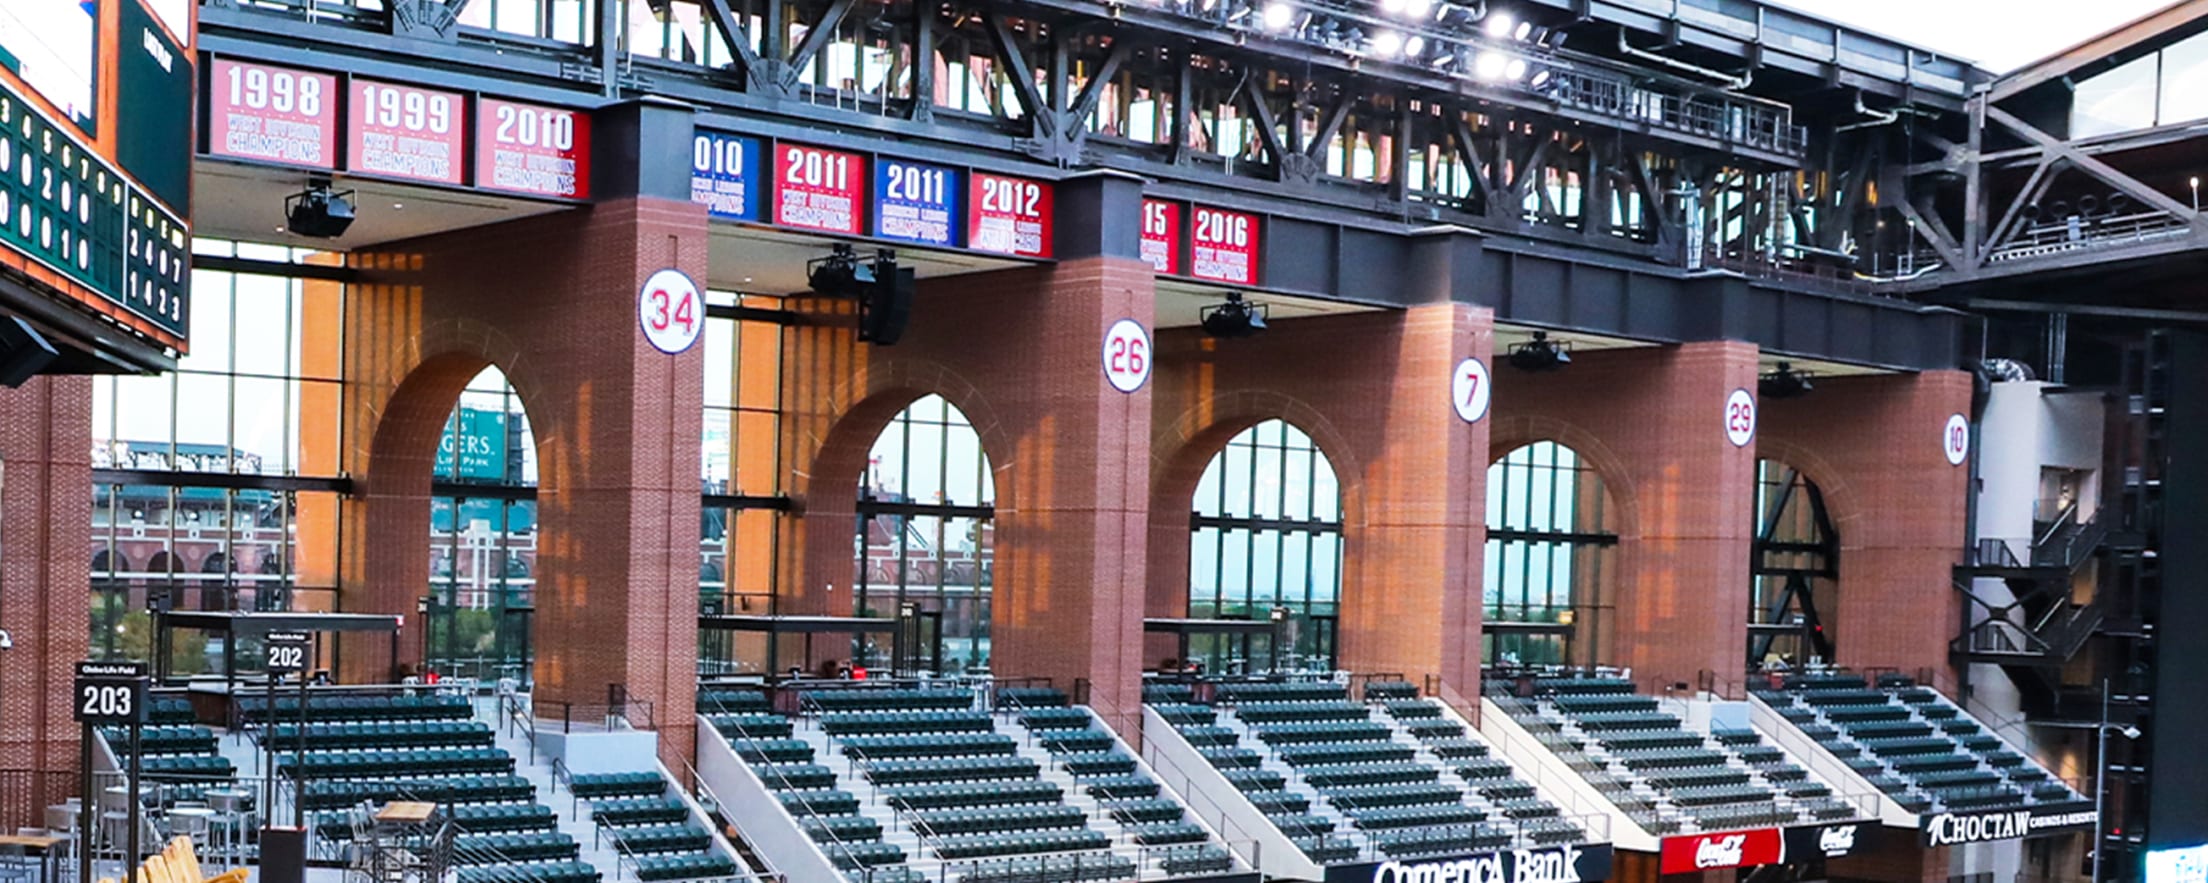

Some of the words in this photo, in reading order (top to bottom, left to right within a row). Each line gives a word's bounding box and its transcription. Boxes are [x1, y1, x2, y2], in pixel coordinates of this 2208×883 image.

[227, 65, 320, 117] 1998
[363, 85, 449, 133] 1999
[23, 115, 31, 139] 4
[44, 129, 52, 154] 5
[80, 157, 88, 181] 7
[225, 130, 321, 163] CHAMPIONS
[496, 105, 573, 151] 2010
[694, 136, 743, 175] 010
[786, 148, 847, 190] 2011
[886, 164, 943, 204] 2011
[981, 177, 1040, 217] 2012
[0, 137, 10, 172] 0
[22, 152, 32, 187] 0
[42, 167, 52, 200] 2
[61, 180, 71, 212] 0
[80, 193, 89, 224] 0
[130, 228, 138, 257] 2
[145, 239, 153, 266] 4
[160, 249, 167, 275] 0
[173, 258, 181, 283] 7
[1144, 202, 1167, 236] 15
[1195, 210, 1248, 248] 2016
[21, 203, 31, 237] 0
[41, 216, 51, 249] 0
[62, 229, 69, 260] 1
[79, 239, 88, 270] 0
[130, 271, 137, 298] 1
[144, 280, 152, 306] 4
[159, 288, 166, 315] 2
[172, 296, 180, 321] 3
[648, 288, 694, 336] 34
[1110, 335, 1144, 376] 26
[1464, 372, 1479, 408] 7
[1730, 401, 1751, 433] 29
[1950, 425, 1964, 453] 10
[268, 646, 303, 667] 202
[82, 685, 132, 716] 203
[1939, 811, 2032, 845] CHOCTAW
[1512, 843, 1583, 883] Bank
